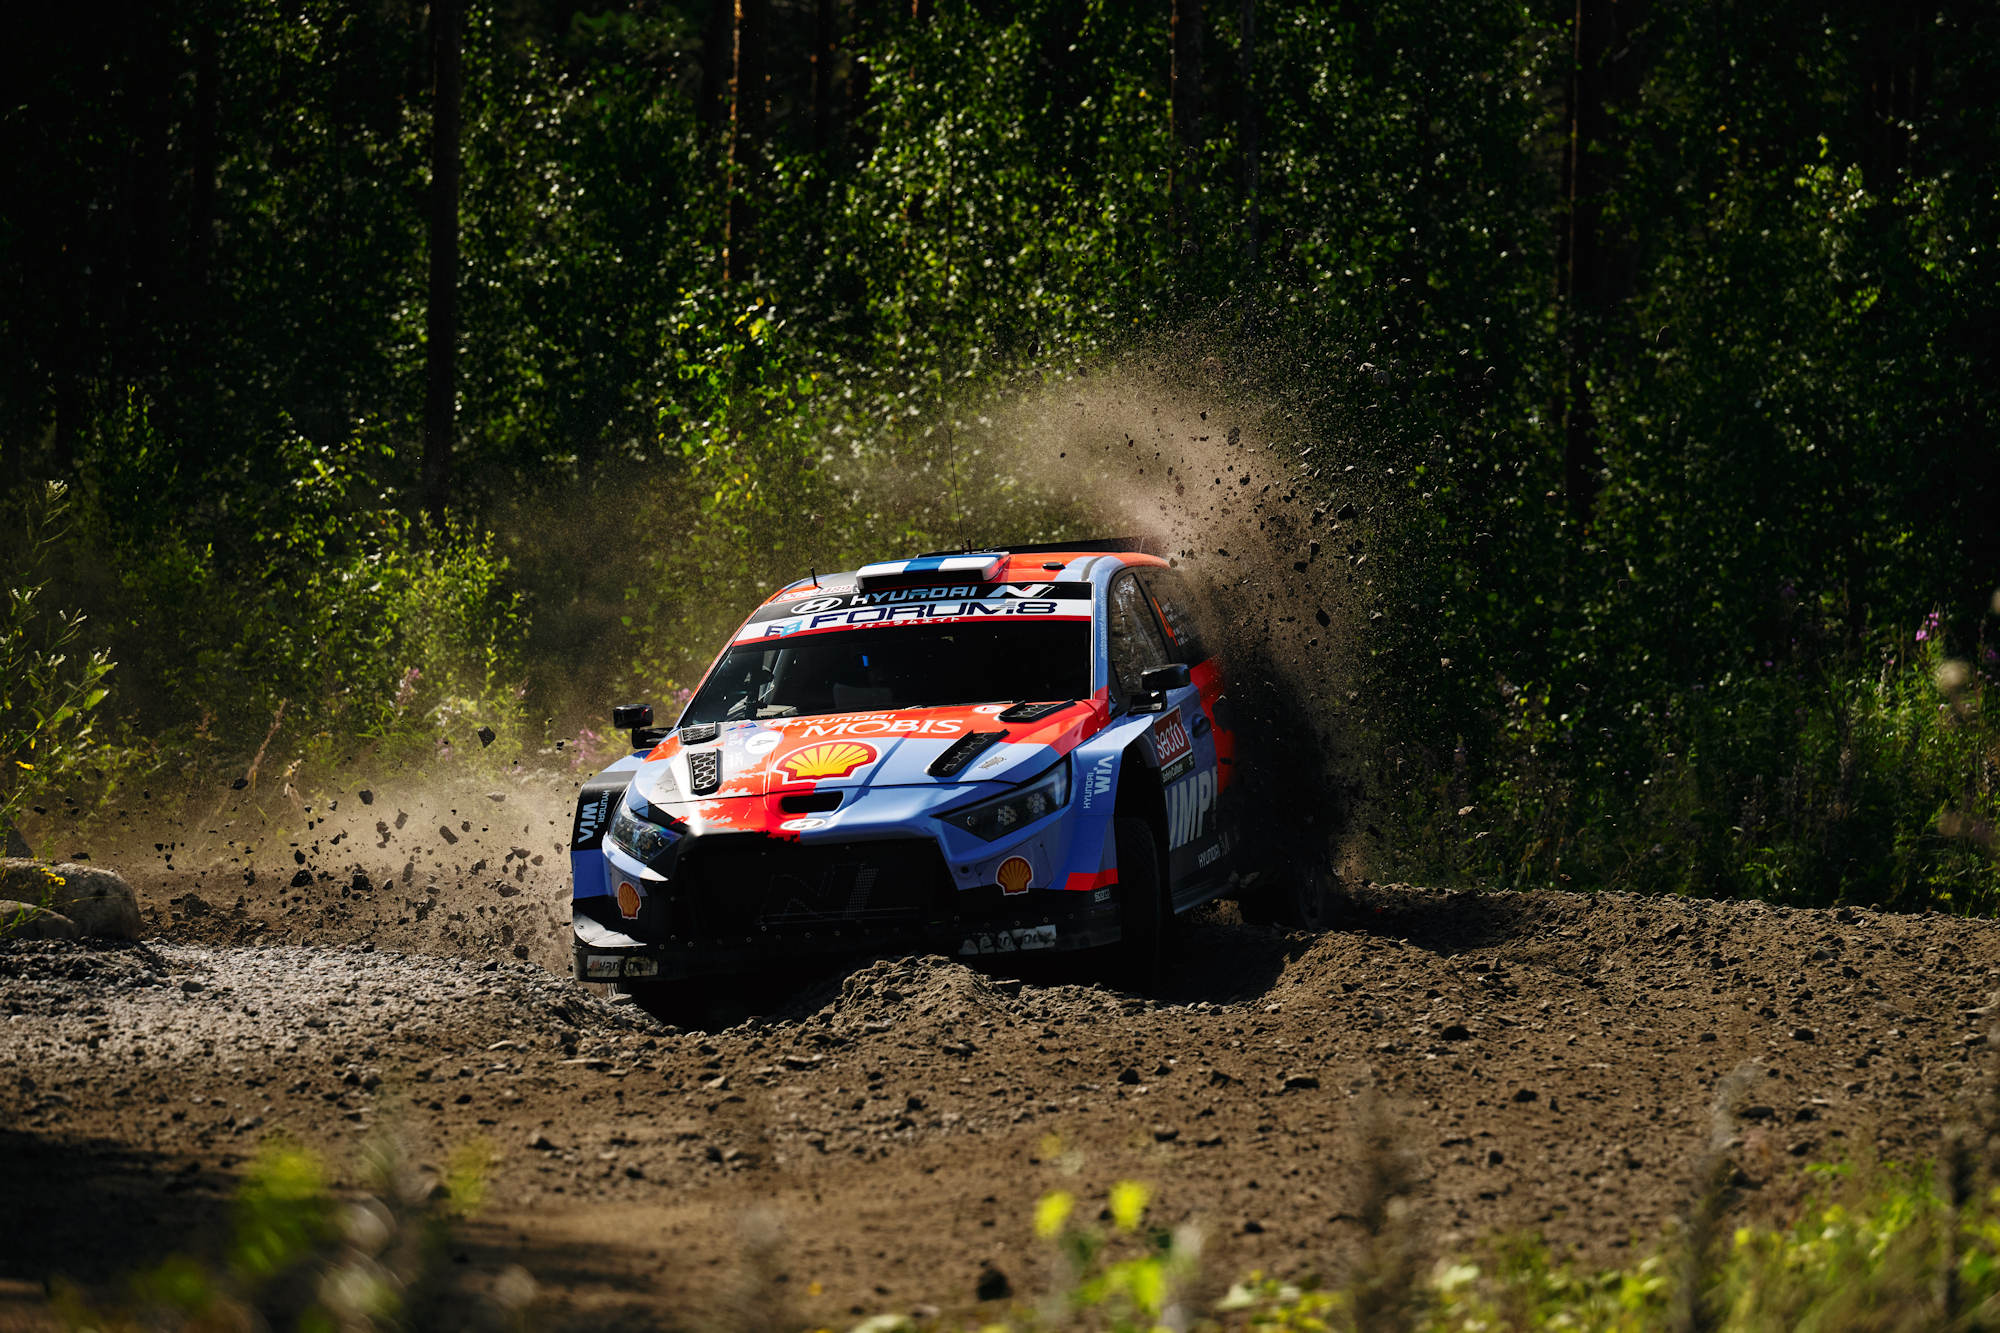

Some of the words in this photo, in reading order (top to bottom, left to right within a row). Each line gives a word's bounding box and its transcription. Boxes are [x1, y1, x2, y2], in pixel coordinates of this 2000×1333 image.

[850, 586, 978, 606] HYUNDAI
[810, 601, 1058, 629] FORUM8
[785, 713, 896, 727] HYUNDAI
[800, 720, 963, 738] MOBIS
[1083, 772, 1094, 809] HYUNDAI
[597, 789, 610, 823] HYUNDAI
